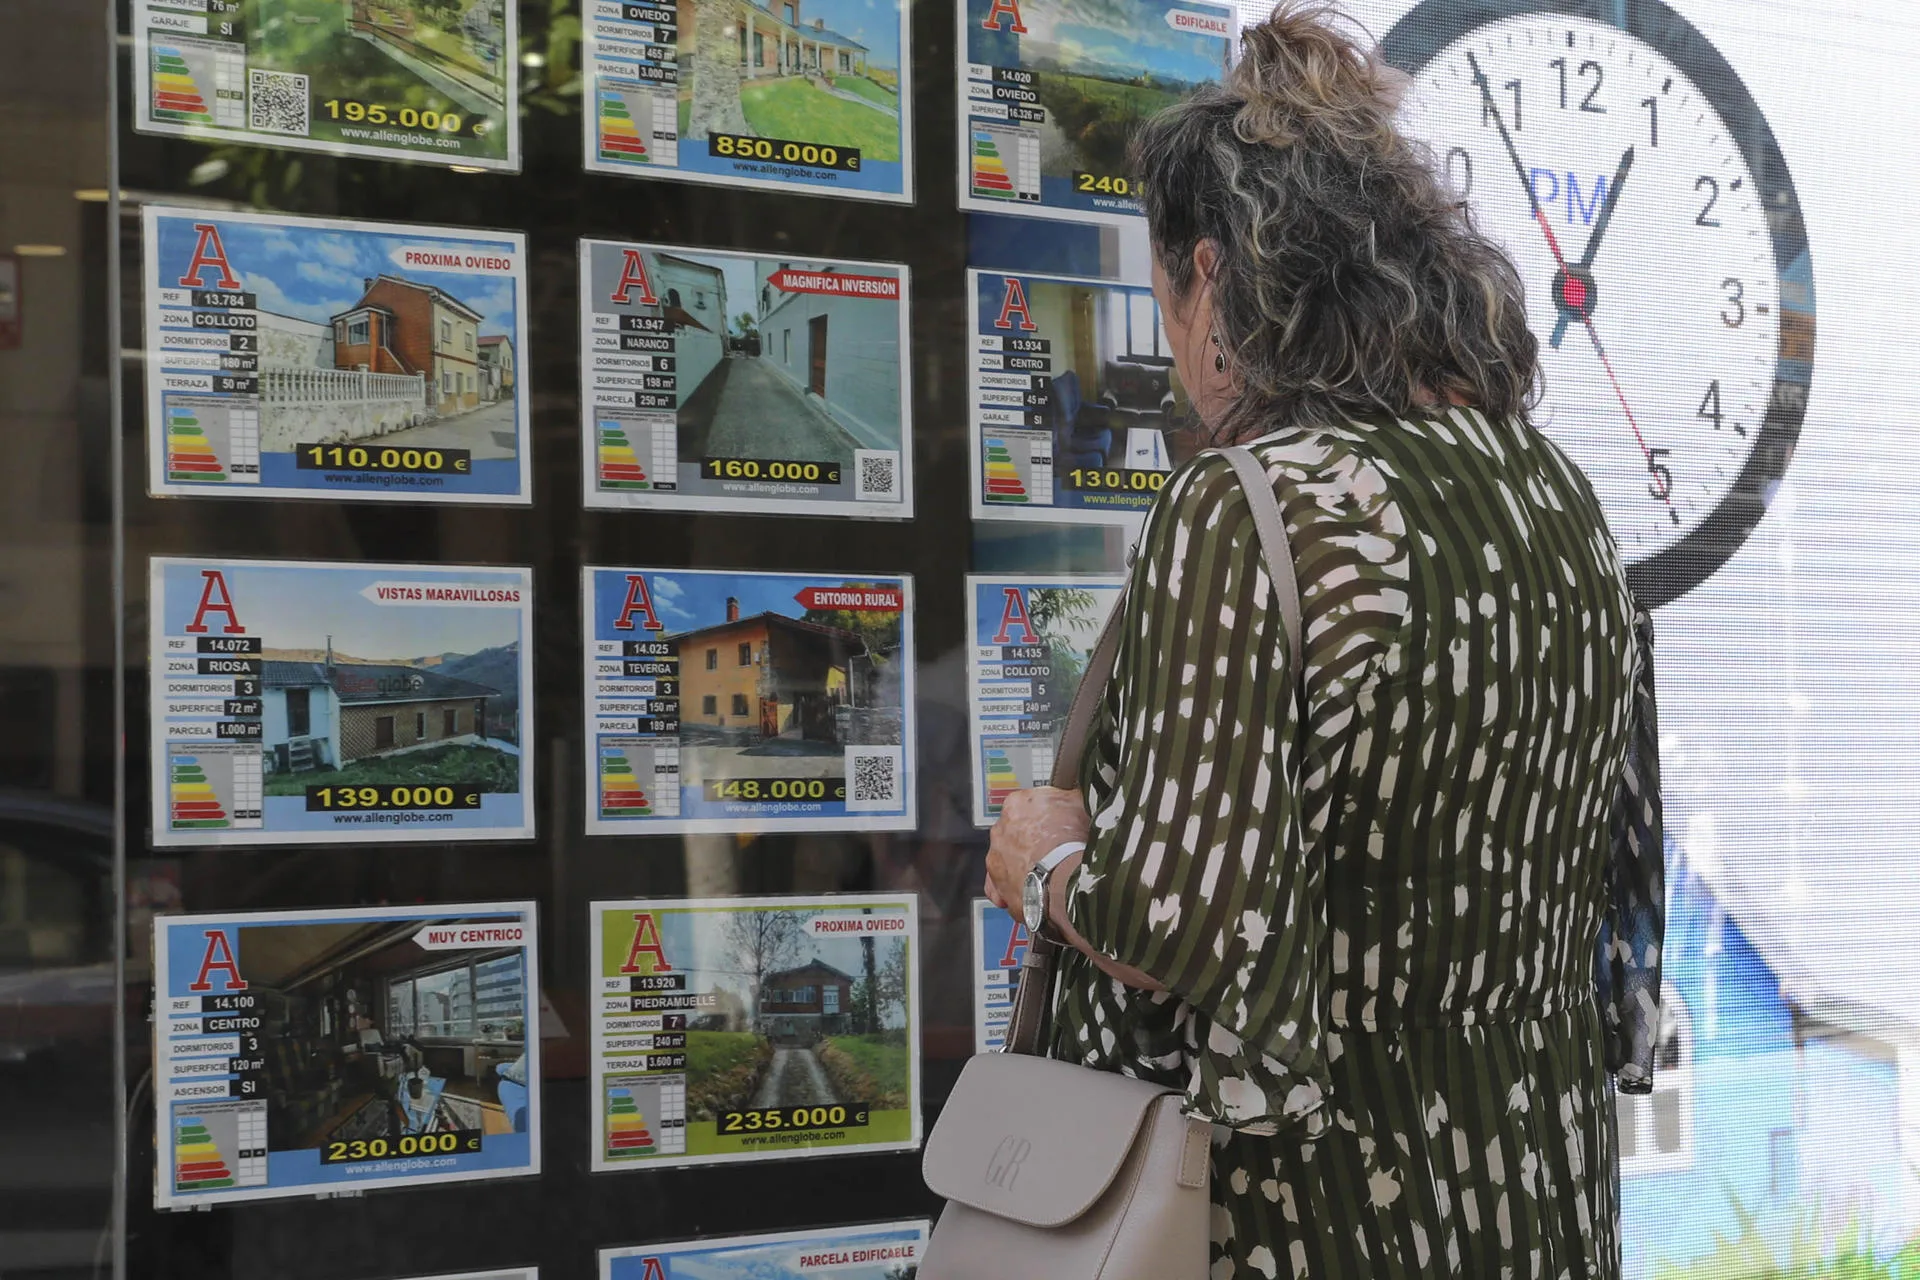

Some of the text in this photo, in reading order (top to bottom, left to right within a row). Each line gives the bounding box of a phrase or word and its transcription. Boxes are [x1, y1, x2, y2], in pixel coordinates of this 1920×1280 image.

[598, 3, 670, 22] ZONA OVIEDO
[152, 16, 232, 35] GARAJE SI
[1175, 15, 1227, 32] EDIFICABLE
[598, 25, 670, 42] DORMITORIOS 7
[598, 43, 644, 55] SUPERFICIE
[598, 64, 635, 75] PARCELA
[1001, 71, 1031, 83] 14.020
[1550, 57, 1607, 114] 12
[997, 88, 1036, 101] OVIEDO
[324, 100, 461, 133] 195.000
[1642, 96, 1658, 147] 1
[341, 126, 460, 148] www.allenglobe.com
[717, 136, 857, 168] 850.000 €
[733, 161, 836, 180] www.allenglobe.com
[1079, 174, 1144, 196] 240.
[1531, 168, 1608, 225] PM
[1695, 176, 1720, 227] 2
[179, 223, 240, 289] A
[406, 252, 510, 270] PROXIMA OVIEDO
[610, 249, 659, 305] A
[783, 274, 896, 295] MAGNIFICA INVERSIÓN
[204, 294, 244, 306] 13.784
[994, 278, 1037, 330] A
[1721, 277, 1744, 328] 3
[163, 315, 254, 327] ZONA COLLOTO
[631, 318, 664, 330] 13.947
[164, 336, 248, 349] DORMITORIOS 2
[627, 338, 669, 349] NARANCO
[1012, 340, 1041, 351] 13.934
[596, 358, 668, 370] DORMITORIOS 6
[1011, 358, 1043, 369] CENTRO
[165, 378, 235, 389] TERRAZA 50
[597, 377, 643, 385] SUPERFICIE
[983, 377, 1043, 388] DORMITORIOS 1
[597, 396, 633, 404] PARCELA
[983, 394, 1037, 405] SUPERFICIE 45
[1697, 379, 1723, 430] 4
[983, 413, 1042, 425] GARAJE SI
[308, 447, 467, 472] 110.000 €
[709, 460, 839, 481] 160.000 €
[1650, 449, 1673, 500] 5
[324, 472, 443, 487] www.allenglobe.com
[1070, 469, 1166, 490] 130.00
[723, 482, 819, 495] www.allenglobe.com
[1083, 494, 1152, 507] www.allenglob
[185, 570, 245, 634] A
[378, 588, 520, 602] VISTAS MARAVILLOSAS
[614, 574, 662, 629] A
[814, 592, 898, 606] ENTORNO RURAL
[992, 588, 1039, 643] A
[210, 640, 249, 651] 14.072
[634, 644, 669, 654] 14.025
[1011, 648, 1042, 657] 14.135
[169, 661, 250, 671] ZONA RIOSA
[629, 664, 671, 673] TEVERGA
[1005, 667, 1049, 676] COLLOTO
[169, 682, 252, 694] DORMITORIOS 3
[600, 683, 671, 694] DORMITORIOS 3
[1038, 684, 1045, 695] 5
[229, 703, 241, 713] 72
[649, 703, 664, 712] 150
[170, 723, 245, 735] PARCELA 1.000
[600, 722, 636, 730] PARCELA
[712, 781, 824, 799] 148.000
[317, 787, 478, 808] 139.000 €
[725, 802, 821, 814] www.allenglobe.com
[334, 811, 452, 824] www.allenglobe.com
[815, 919, 904, 932] PROXIMA OVIEDO
[429, 929, 522, 944] MUY CENTRICO
[620, 913, 672, 973] A
[189, 930, 248, 991] A
[641, 978, 675, 989] 13.920
[214, 997, 254, 1009] 14.100
[635, 996, 716, 1008] PIEDRAMUELLE
[173, 1018, 260, 1032] ZONA CENTRO
[606, 1017, 678, 1029] DORMITORIOS 7
[174, 1038, 257, 1053] DORMITORIOS 3
[606, 1040, 652, 1048] SUPERFICIE
[174, 1060, 249, 1073] SUPERFICIE 120
[175, 1081, 255, 1096] ASCENSOR SI
[725, 1107, 866, 1131] 235.000 €
[741, 1131, 844, 1146] www.allenglobe.com
[329, 1134, 479, 1161] 230.000 €
[345, 1157, 457, 1175] www.allenglobe.com
[800, 1246, 914, 1268] PARCELA EDIFICABLE
